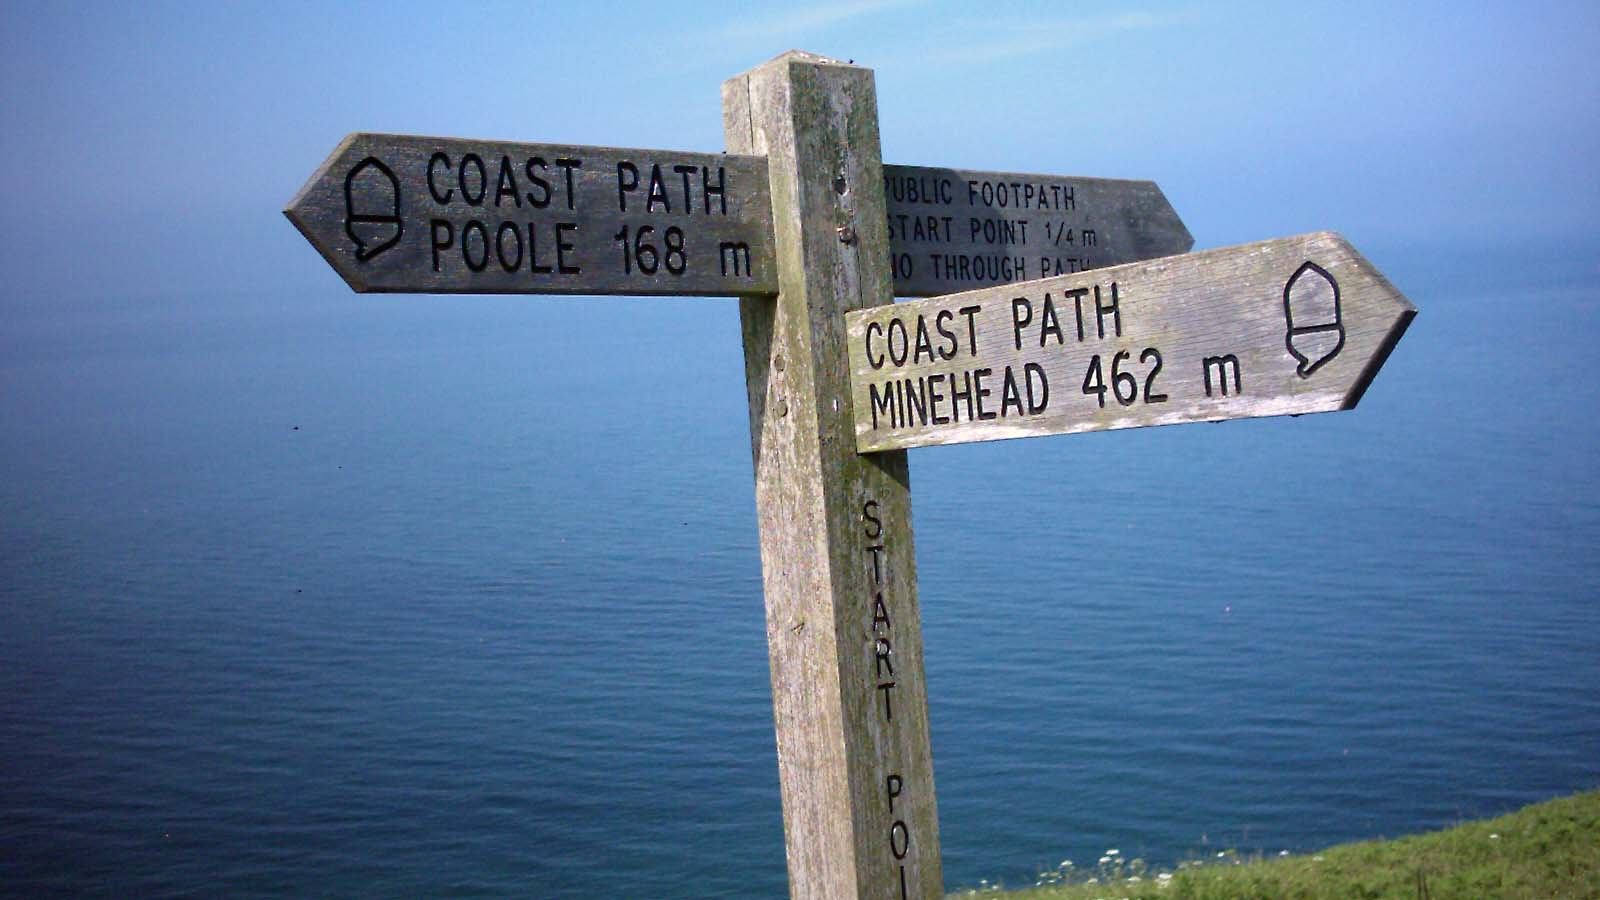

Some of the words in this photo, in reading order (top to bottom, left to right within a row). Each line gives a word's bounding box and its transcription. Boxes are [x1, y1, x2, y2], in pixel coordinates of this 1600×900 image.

[426, 151, 582, 209] COAST
[617, 160, 728, 216] PATH
[968, 180, 1076, 211] FOOTPATH
[430, 220, 581, 275] POOLE
[614, 225, 687, 277] 168
[720, 240, 752, 278] m
[888, 214, 953, 243] START
[971, 217, 1029, 245] POINT
[1045, 221, 1074, 246] 1/4
[1082, 229, 1097, 247] m
[931, 254, 1026, 282] THROUGH
[865, 305, 982, 371] COAST
[1012, 281, 1122, 351] PATH
[869, 362, 1050, 430] MINEHEAD
[1081, 347, 1169, 409] 462
[1203, 353, 1242, 398] m
[862, 500, 896, 724] START
